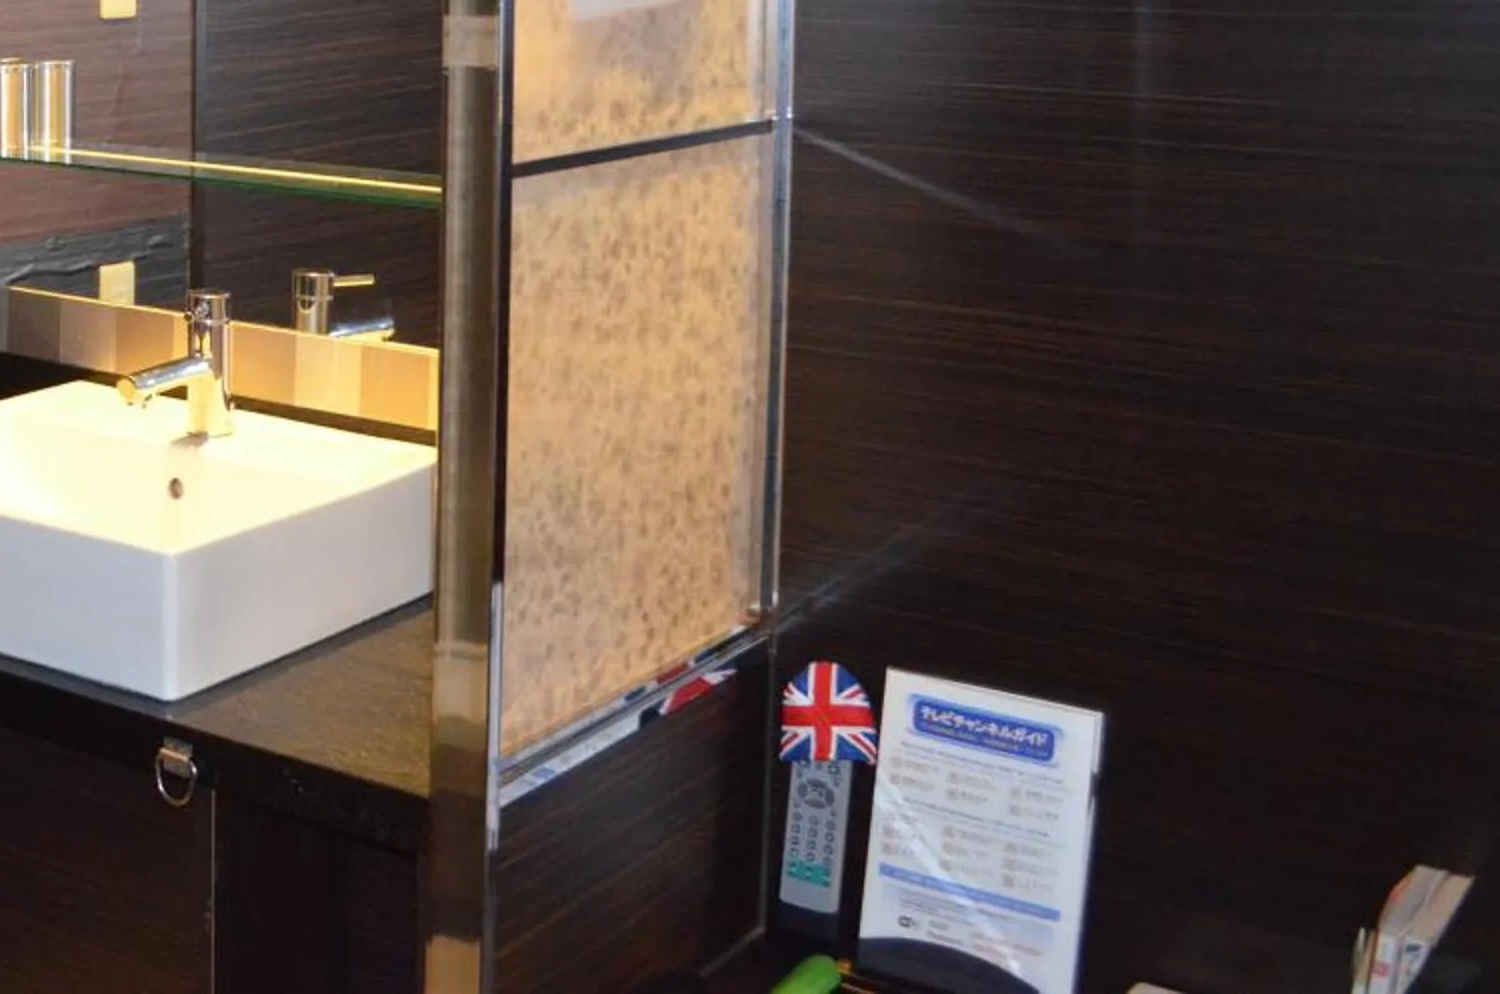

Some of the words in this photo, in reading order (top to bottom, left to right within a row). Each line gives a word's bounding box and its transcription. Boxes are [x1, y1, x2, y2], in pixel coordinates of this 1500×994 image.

[920, 705, 1048, 747] テレビチャンネルガイド
